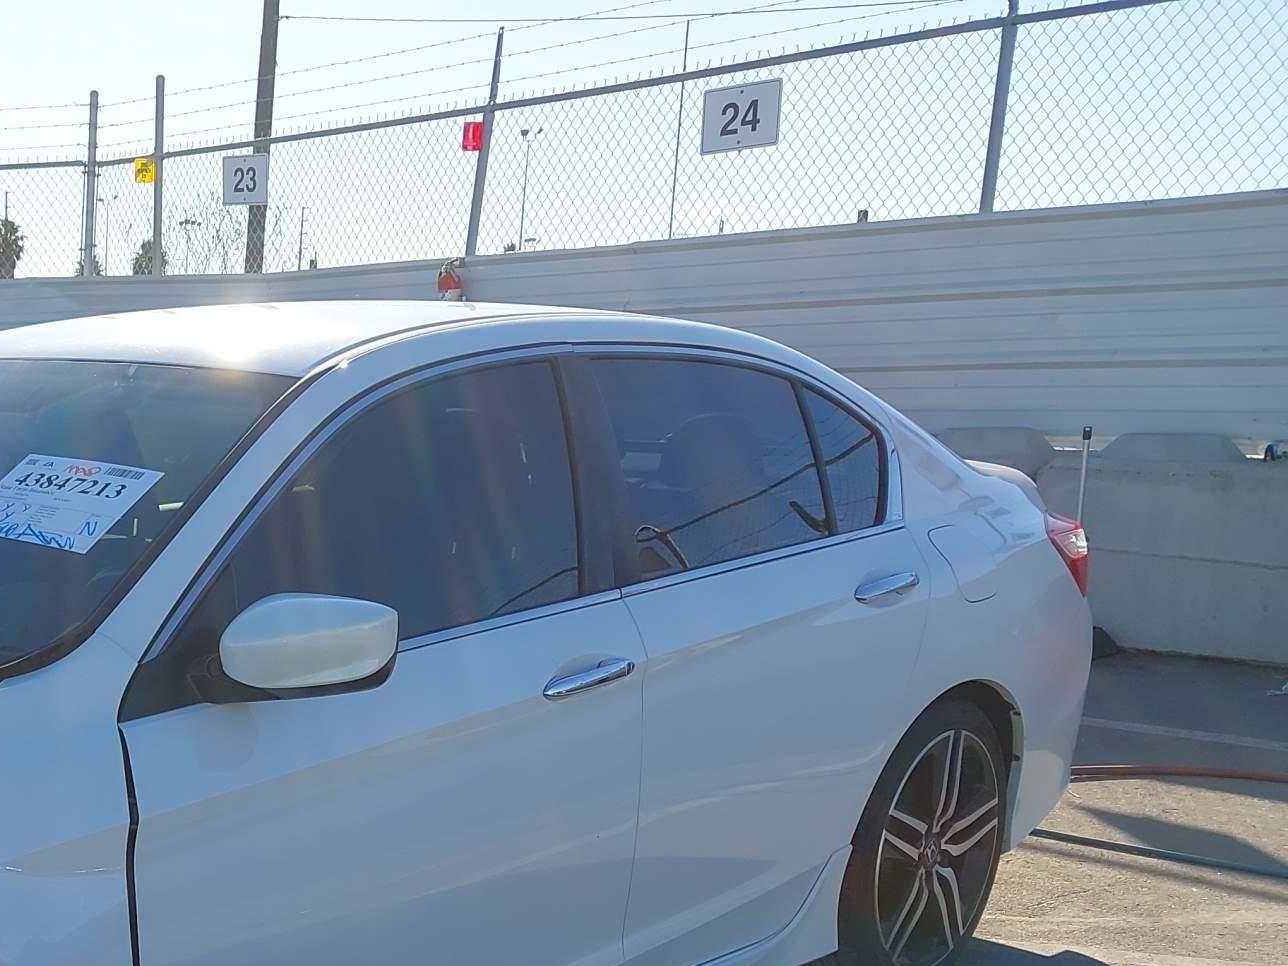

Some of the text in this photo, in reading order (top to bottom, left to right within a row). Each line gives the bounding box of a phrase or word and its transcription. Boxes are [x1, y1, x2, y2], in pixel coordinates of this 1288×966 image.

[719, 98, 761, 137] 24
[233, 166, 257, 193] 23
[14, 471, 128, 500] 43847213
